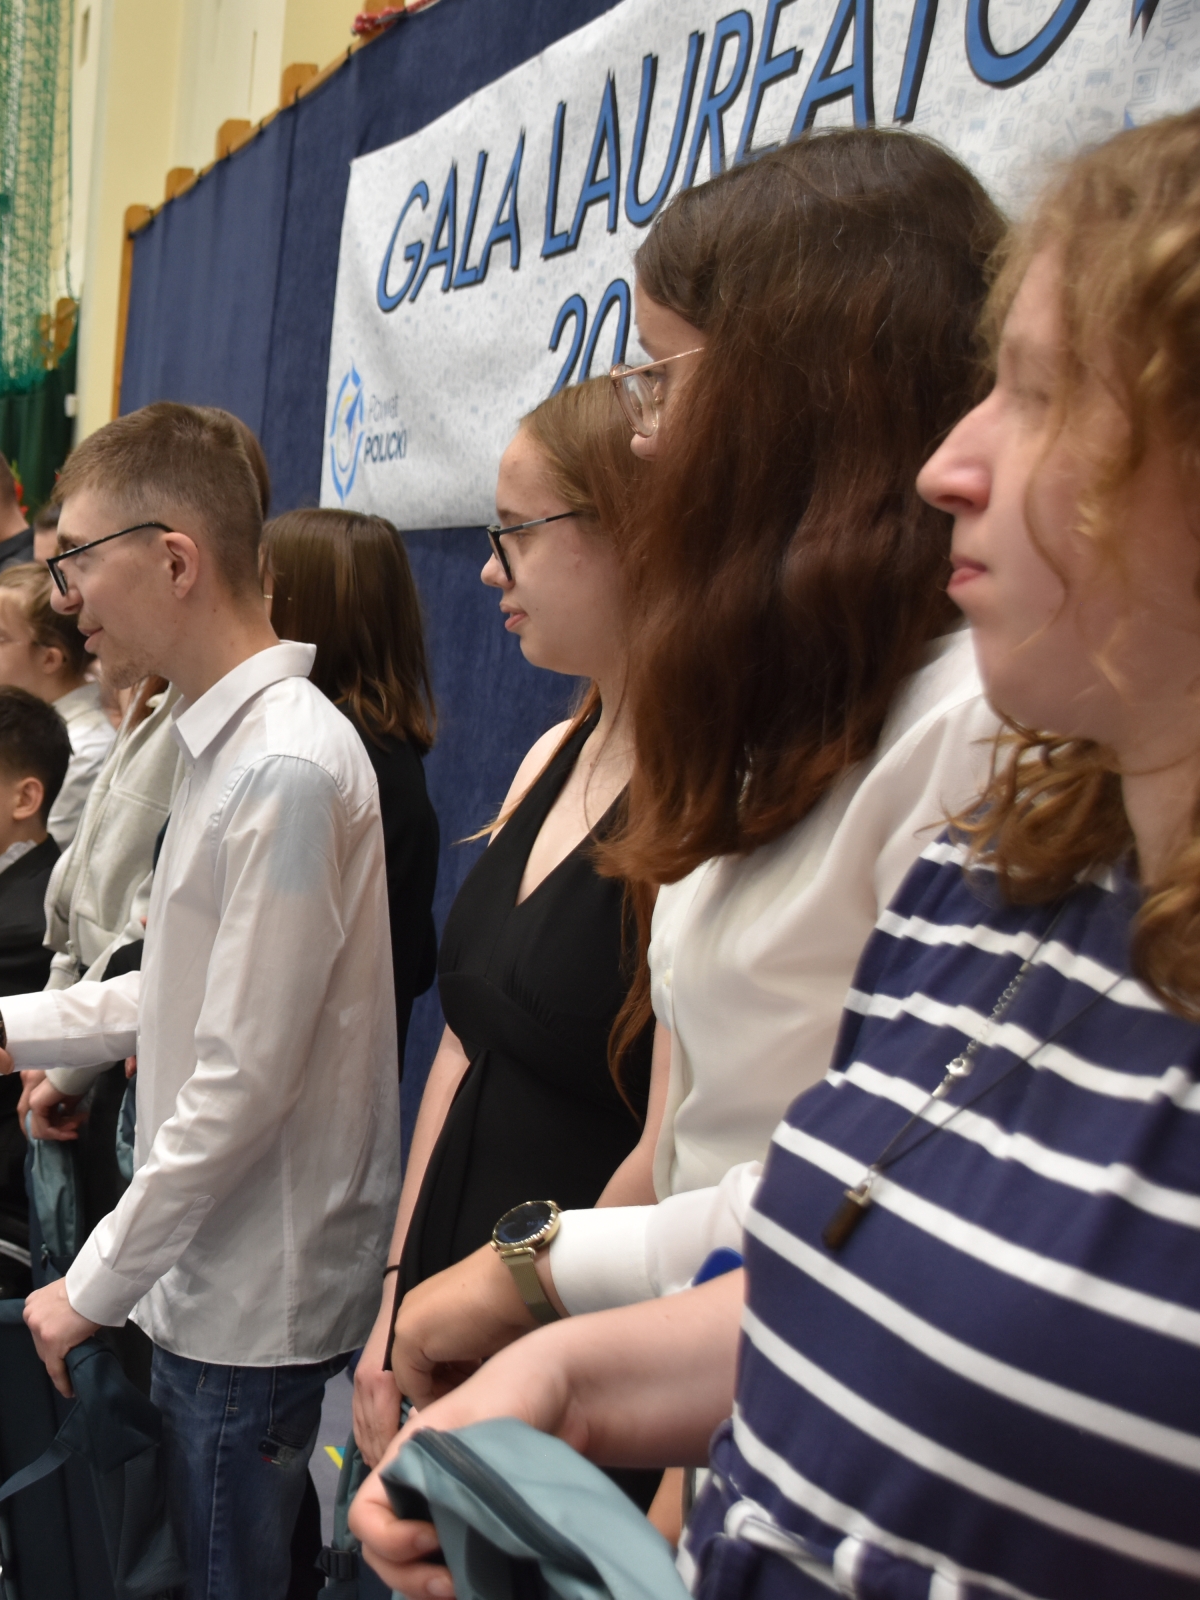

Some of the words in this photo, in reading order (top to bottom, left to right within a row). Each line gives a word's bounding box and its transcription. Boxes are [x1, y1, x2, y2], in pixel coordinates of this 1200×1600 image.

[376, 126, 526, 314] GALA
[540, 0, 1159, 260] LAUREAT
[363, 428, 407, 464] POLICKI
